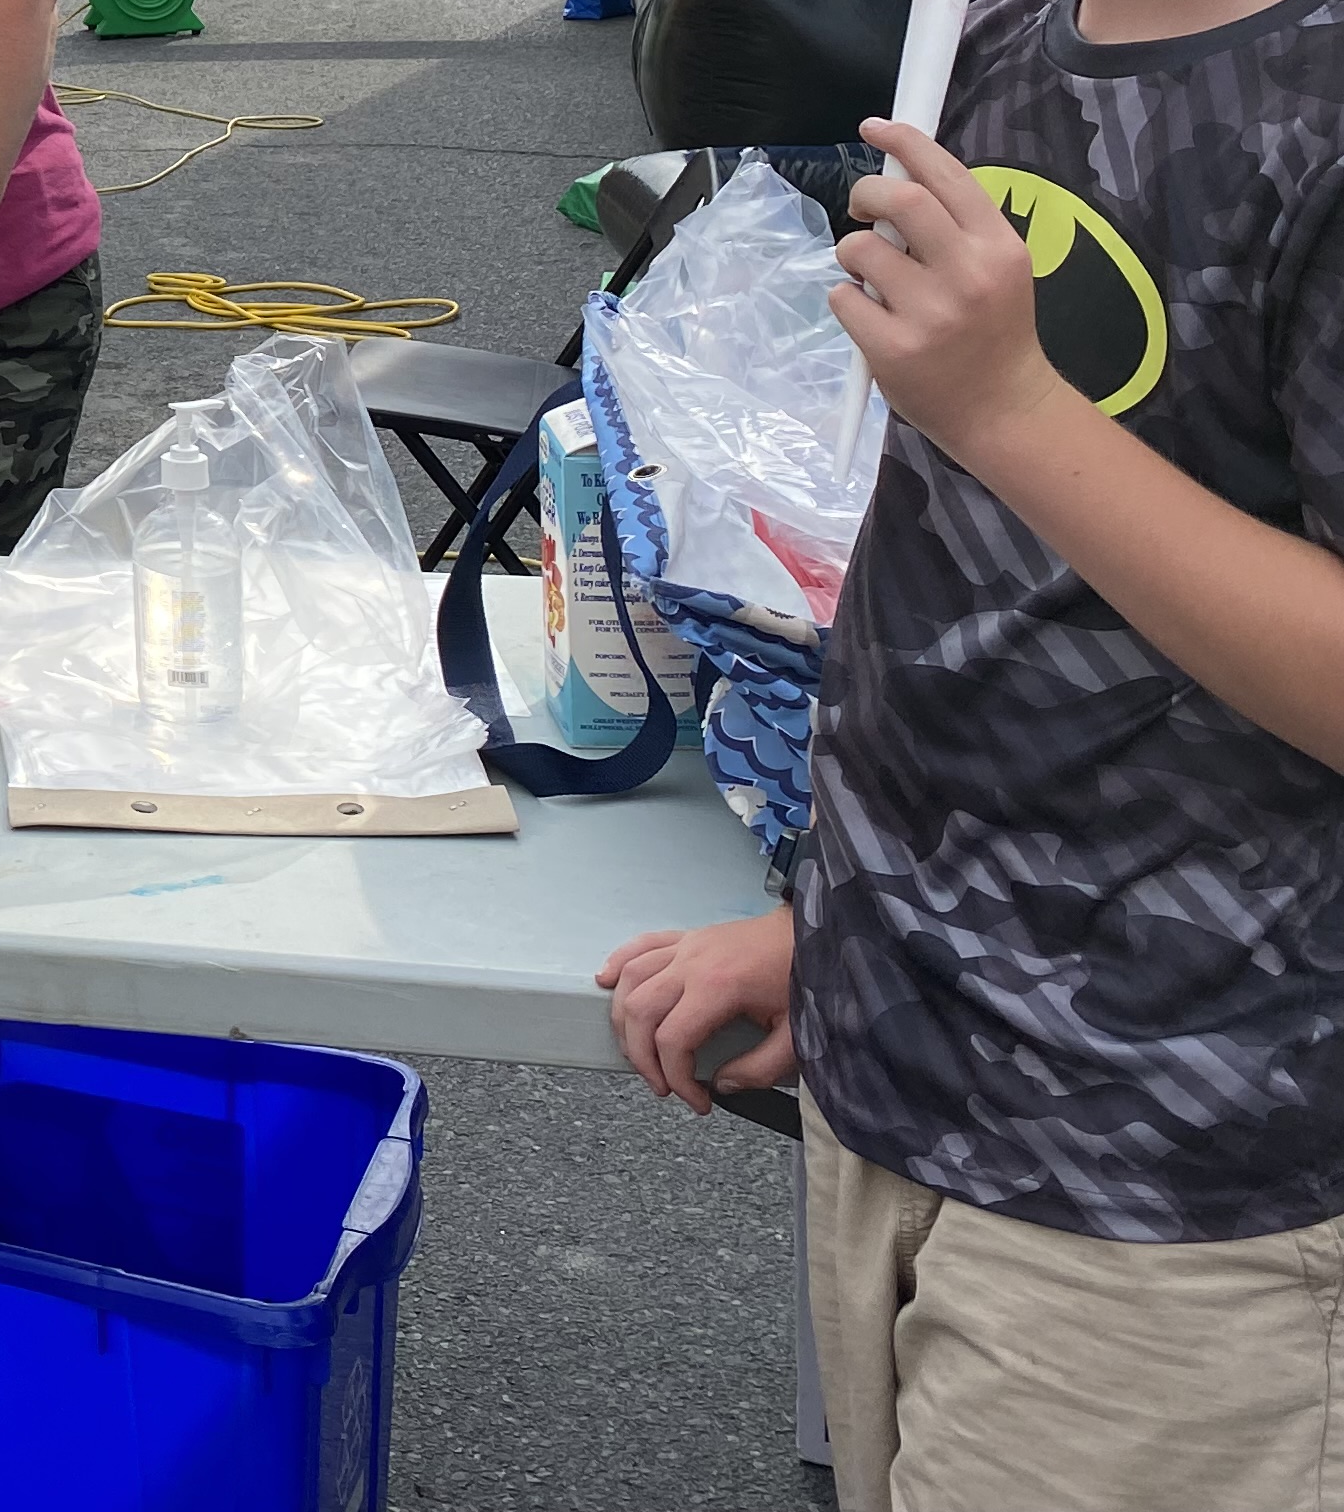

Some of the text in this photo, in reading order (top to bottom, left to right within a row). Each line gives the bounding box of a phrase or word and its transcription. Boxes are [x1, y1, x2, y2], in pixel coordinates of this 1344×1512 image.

[581, 473, 593, 488] To
[577, 511, 591, 525] We
[578, 562, 594, 575] Keep
[580, 578, 593, 592] Vary
